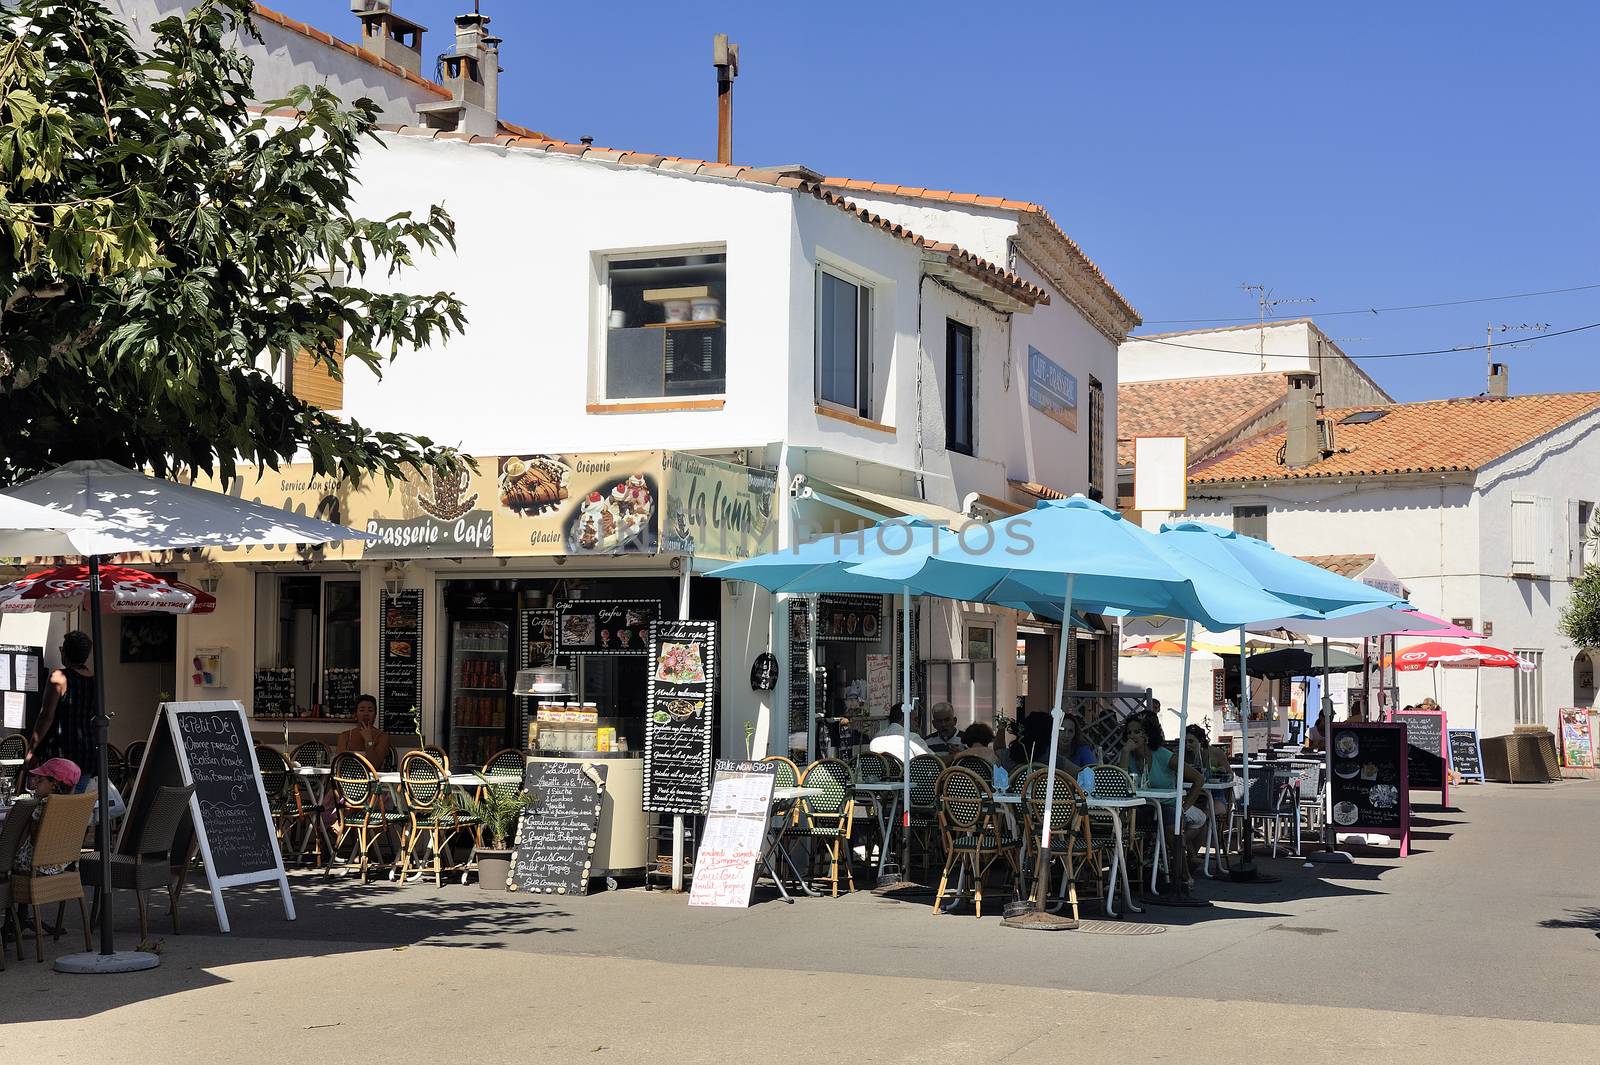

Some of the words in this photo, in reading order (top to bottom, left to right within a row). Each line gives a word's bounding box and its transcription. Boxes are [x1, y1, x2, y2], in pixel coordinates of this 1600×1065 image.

[576, 459, 612, 475] Crêperie
[280, 479, 306, 492] Service
[688, 475, 707, 527] La
[366, 520, 439, 548] Brasserie
[453, 517, 492, 548] Café
[530, 530, 562, 546] Glacier
[186, 715, 212, 734] Petit
[211, 715, 239, 746] Déj
[752, 762, 774, 772] STOP
